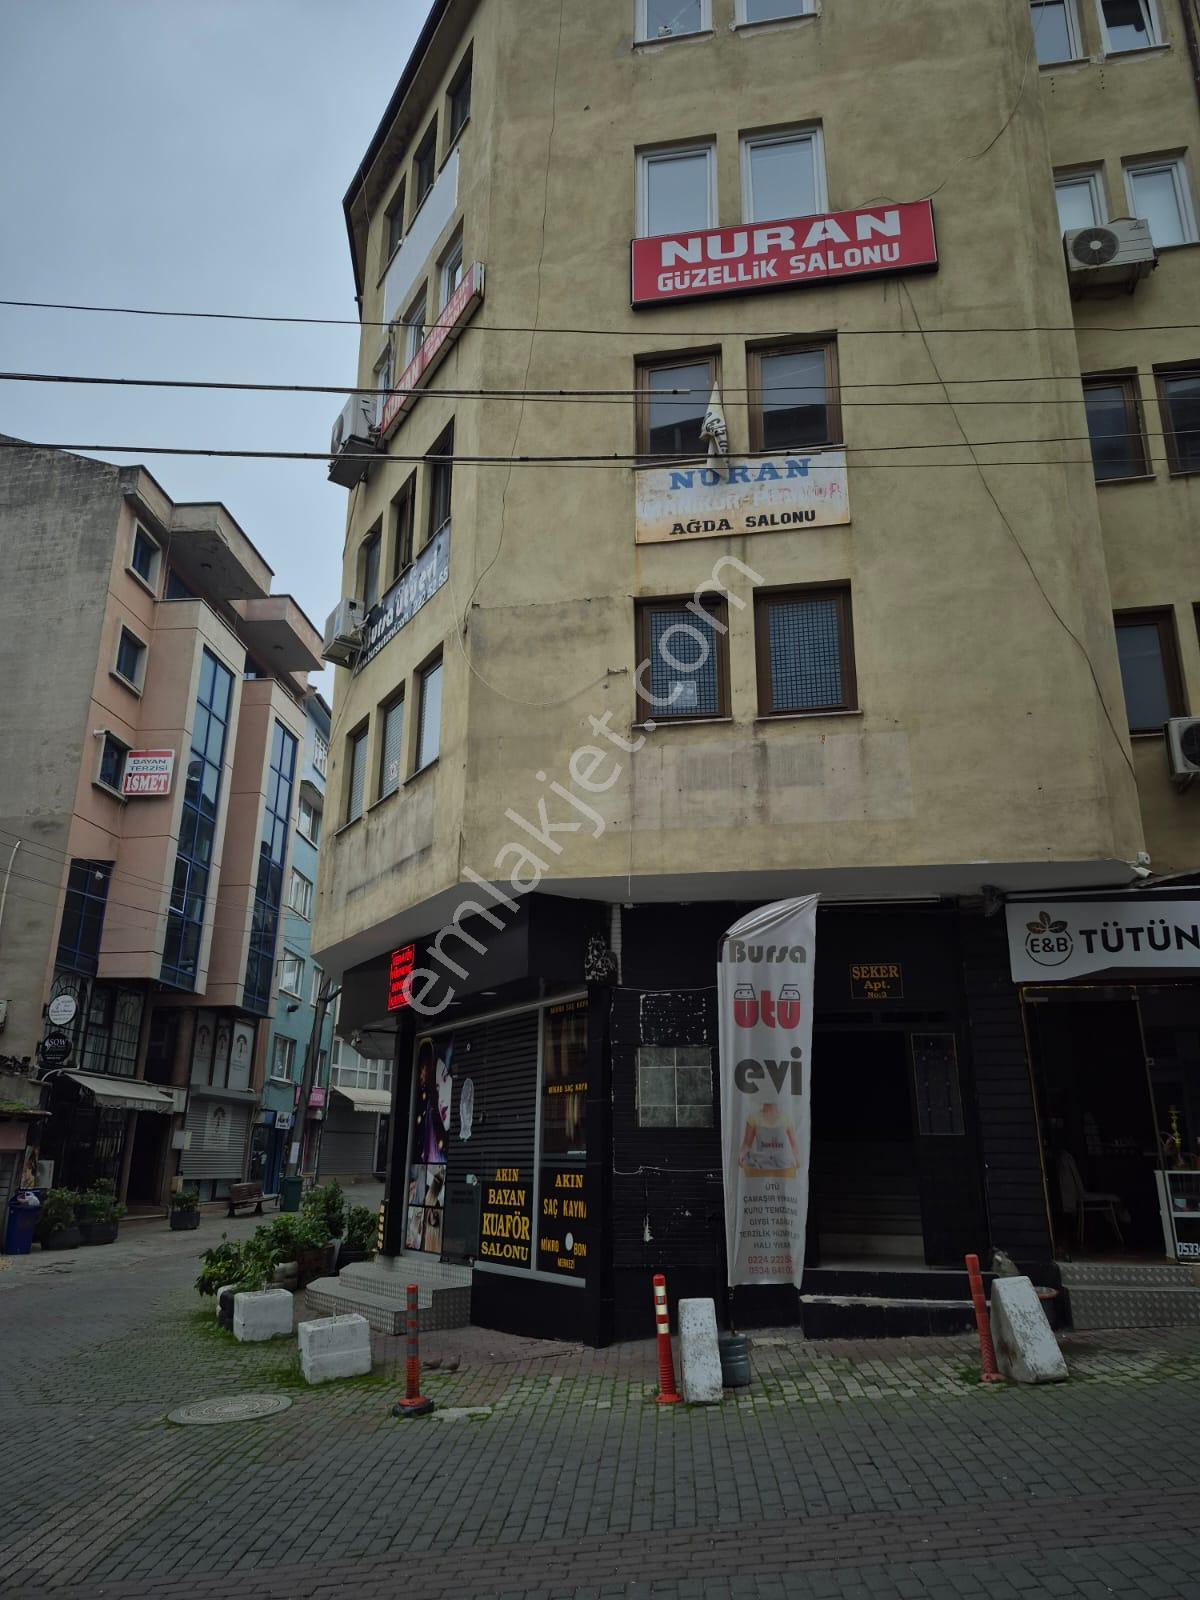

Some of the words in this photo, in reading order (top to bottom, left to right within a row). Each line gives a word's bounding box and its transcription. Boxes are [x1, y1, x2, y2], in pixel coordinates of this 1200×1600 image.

[661, 210, 901, 267] NURAN
[790, 242, 900, 275] SALONU
[669, 458, 811, 490] NURAN
[669, 518, 734, 535] AĞDA
[745, 509, 816, 528] SALONU
[1030, 937, 1068, 953] E&B
[1079, 919, 1200, 953] TÜTÜN
[729, 939, 807, 964] Bursa
[864, 980, 891, 991] Apt.
[734, 1047, 803, 1097] evi
[495, 1168, 519, 1182] AKIN
[555, 1174, 584, 1188] AKIN
[488, 1189, 526, 1207] BAYAN
[543, 1198, 558, 1219] SAÇ
[482, 1210, 530, 1240] KUAFÖR
[481, 1241, 529, 1261] SALONU
